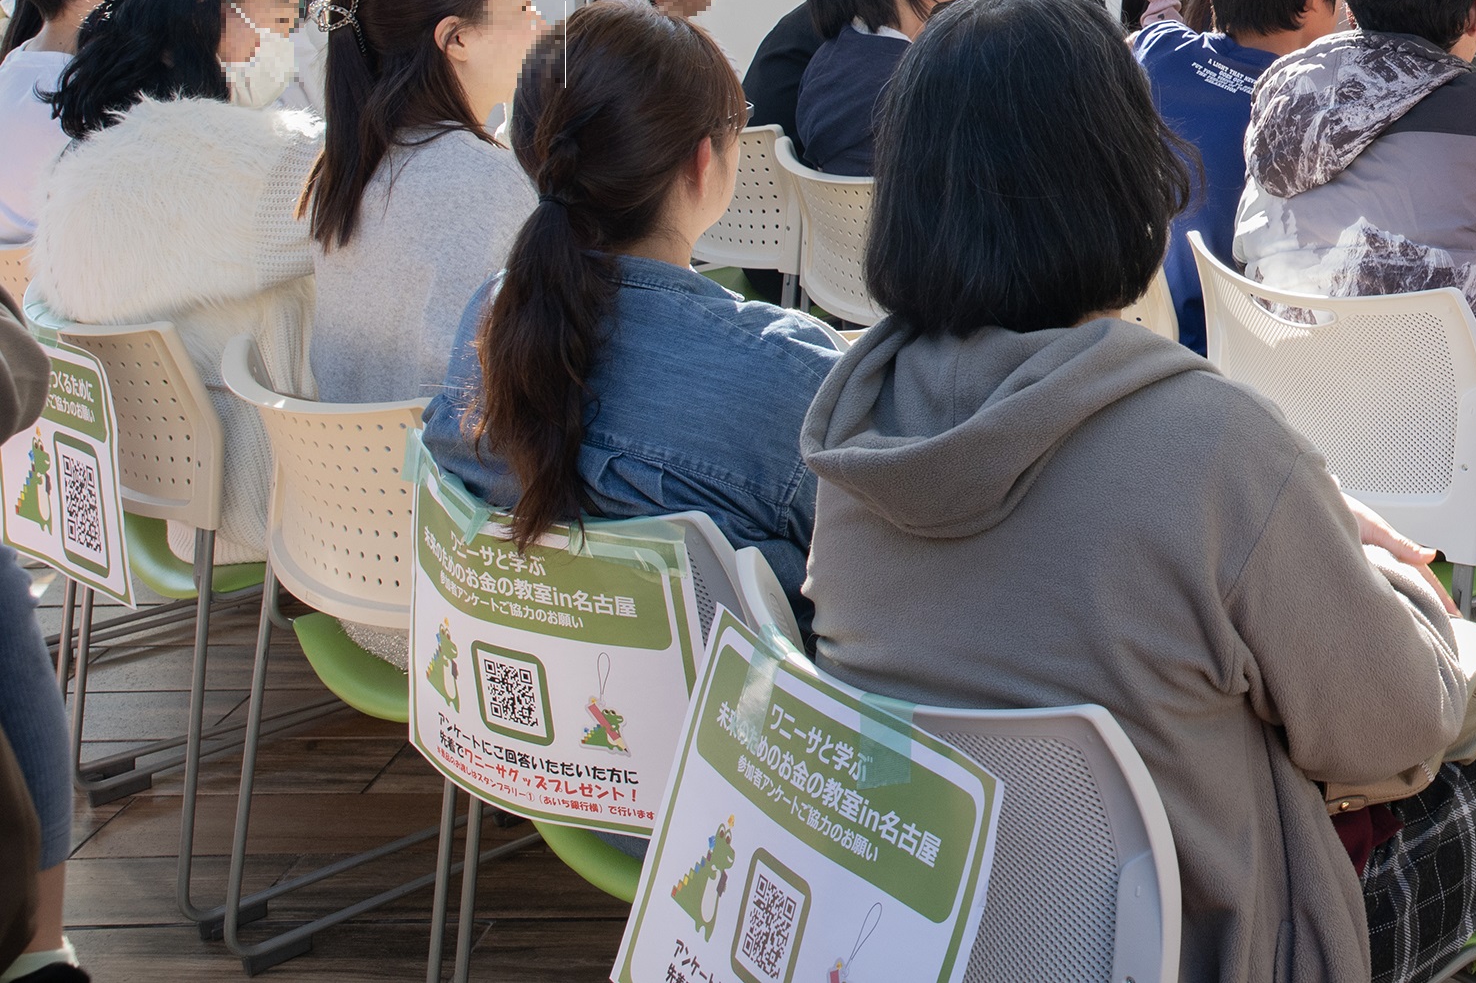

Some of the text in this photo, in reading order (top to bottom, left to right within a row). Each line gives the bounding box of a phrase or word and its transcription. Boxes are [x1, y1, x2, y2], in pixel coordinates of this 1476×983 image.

[1212, 60, 1229, 72] LIGHT
[1229, 68, 1245, 79] THAT
[50, 371, 94, 403] つくるために
[424, 525, 638, 618] 未来のためのお金の教室in名古屋
[450, 529, 547, 576] ワニーサと学ぶ
[440, 570, 584, 630] 参加者アンケートご協力のお願い
[438, 711, 639, 784] アンケートにご回答いただいた方に
[440, 729, 637, 802] 先着でワニーサグッズプレゼント！
[770, 703, 873, 782] ワニーサと学ぶ
[716, 701, 942, 868] 未来のためのお金の教室in名古屋
[737, 754, 879, 863] 参加者アンケートご協力のお願い
